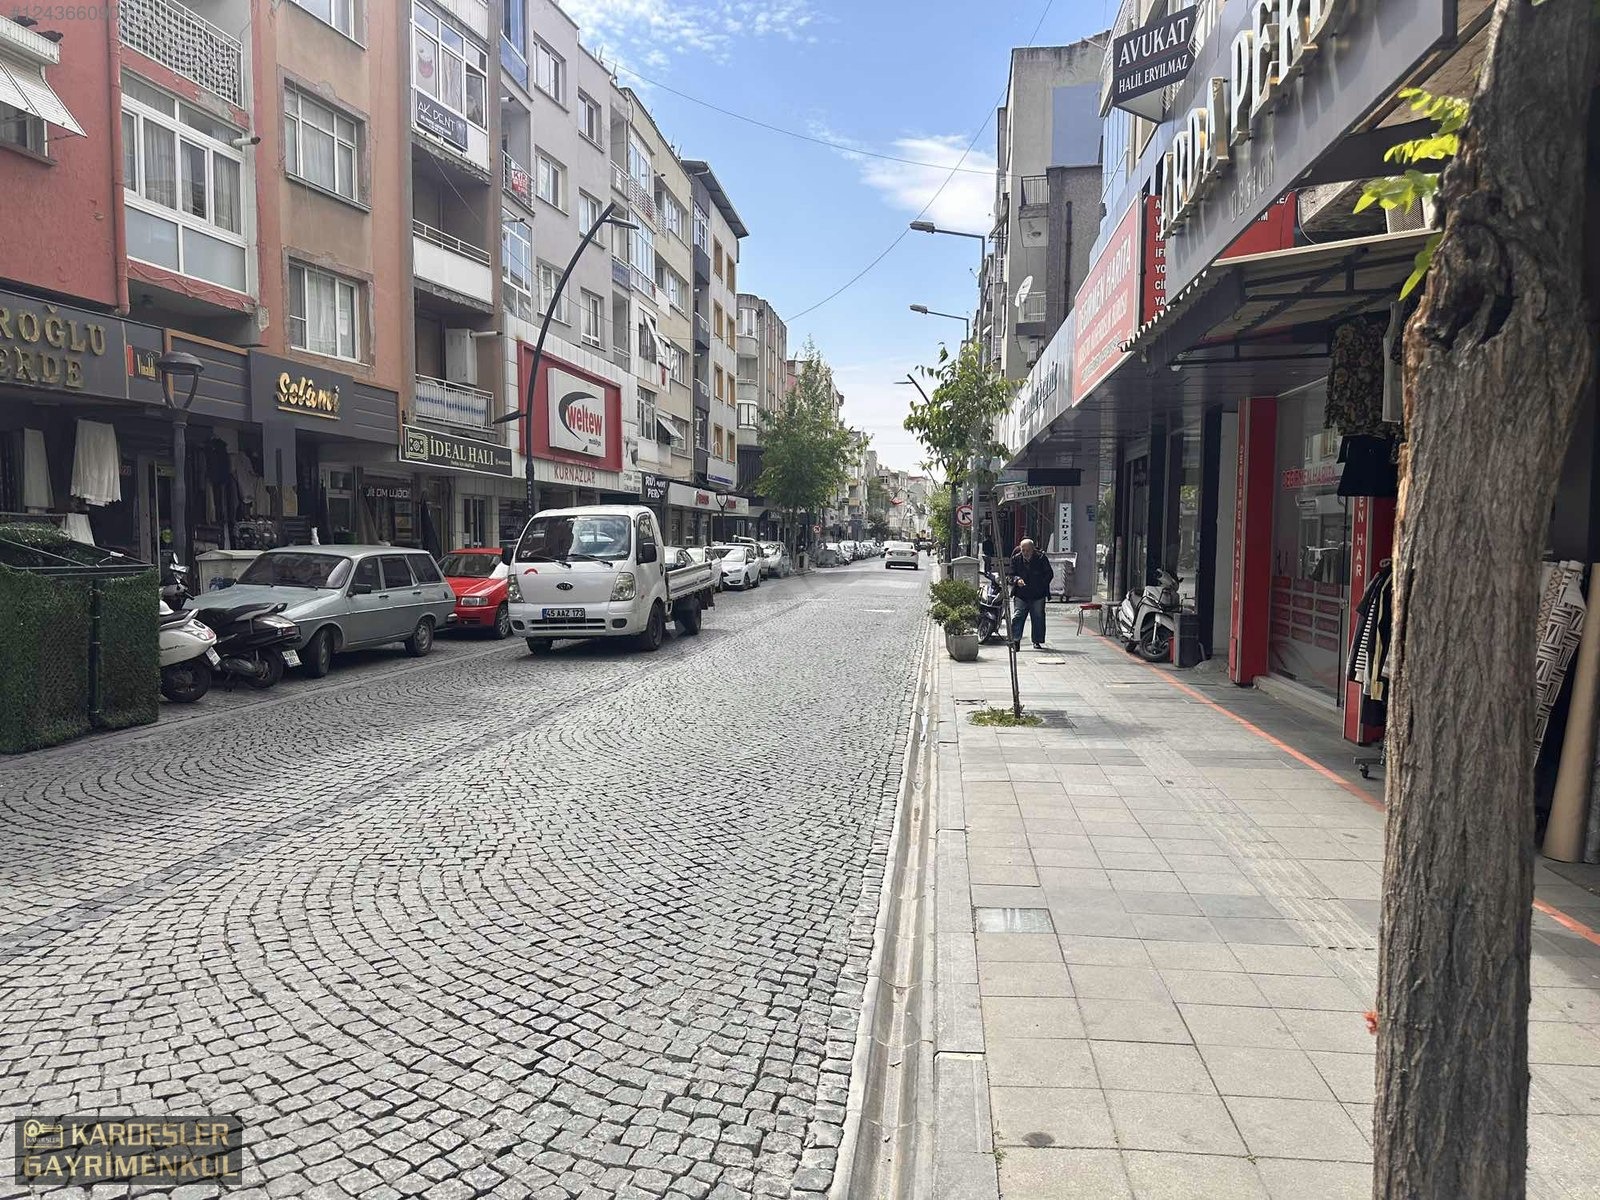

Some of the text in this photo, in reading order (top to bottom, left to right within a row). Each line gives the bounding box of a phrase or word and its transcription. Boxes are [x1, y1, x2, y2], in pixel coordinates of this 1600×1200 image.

[1118, 17, 1189, 68] AVUKAT
[1118, 54, 1188, 94] HALİL ERYILMAZ
[417, 102, 432, 118] AK
[433, 110, 455, 132] DENT
[566, 404, 603, 437] weltew
[429, 435, 494, 466] İDEAL HALI
